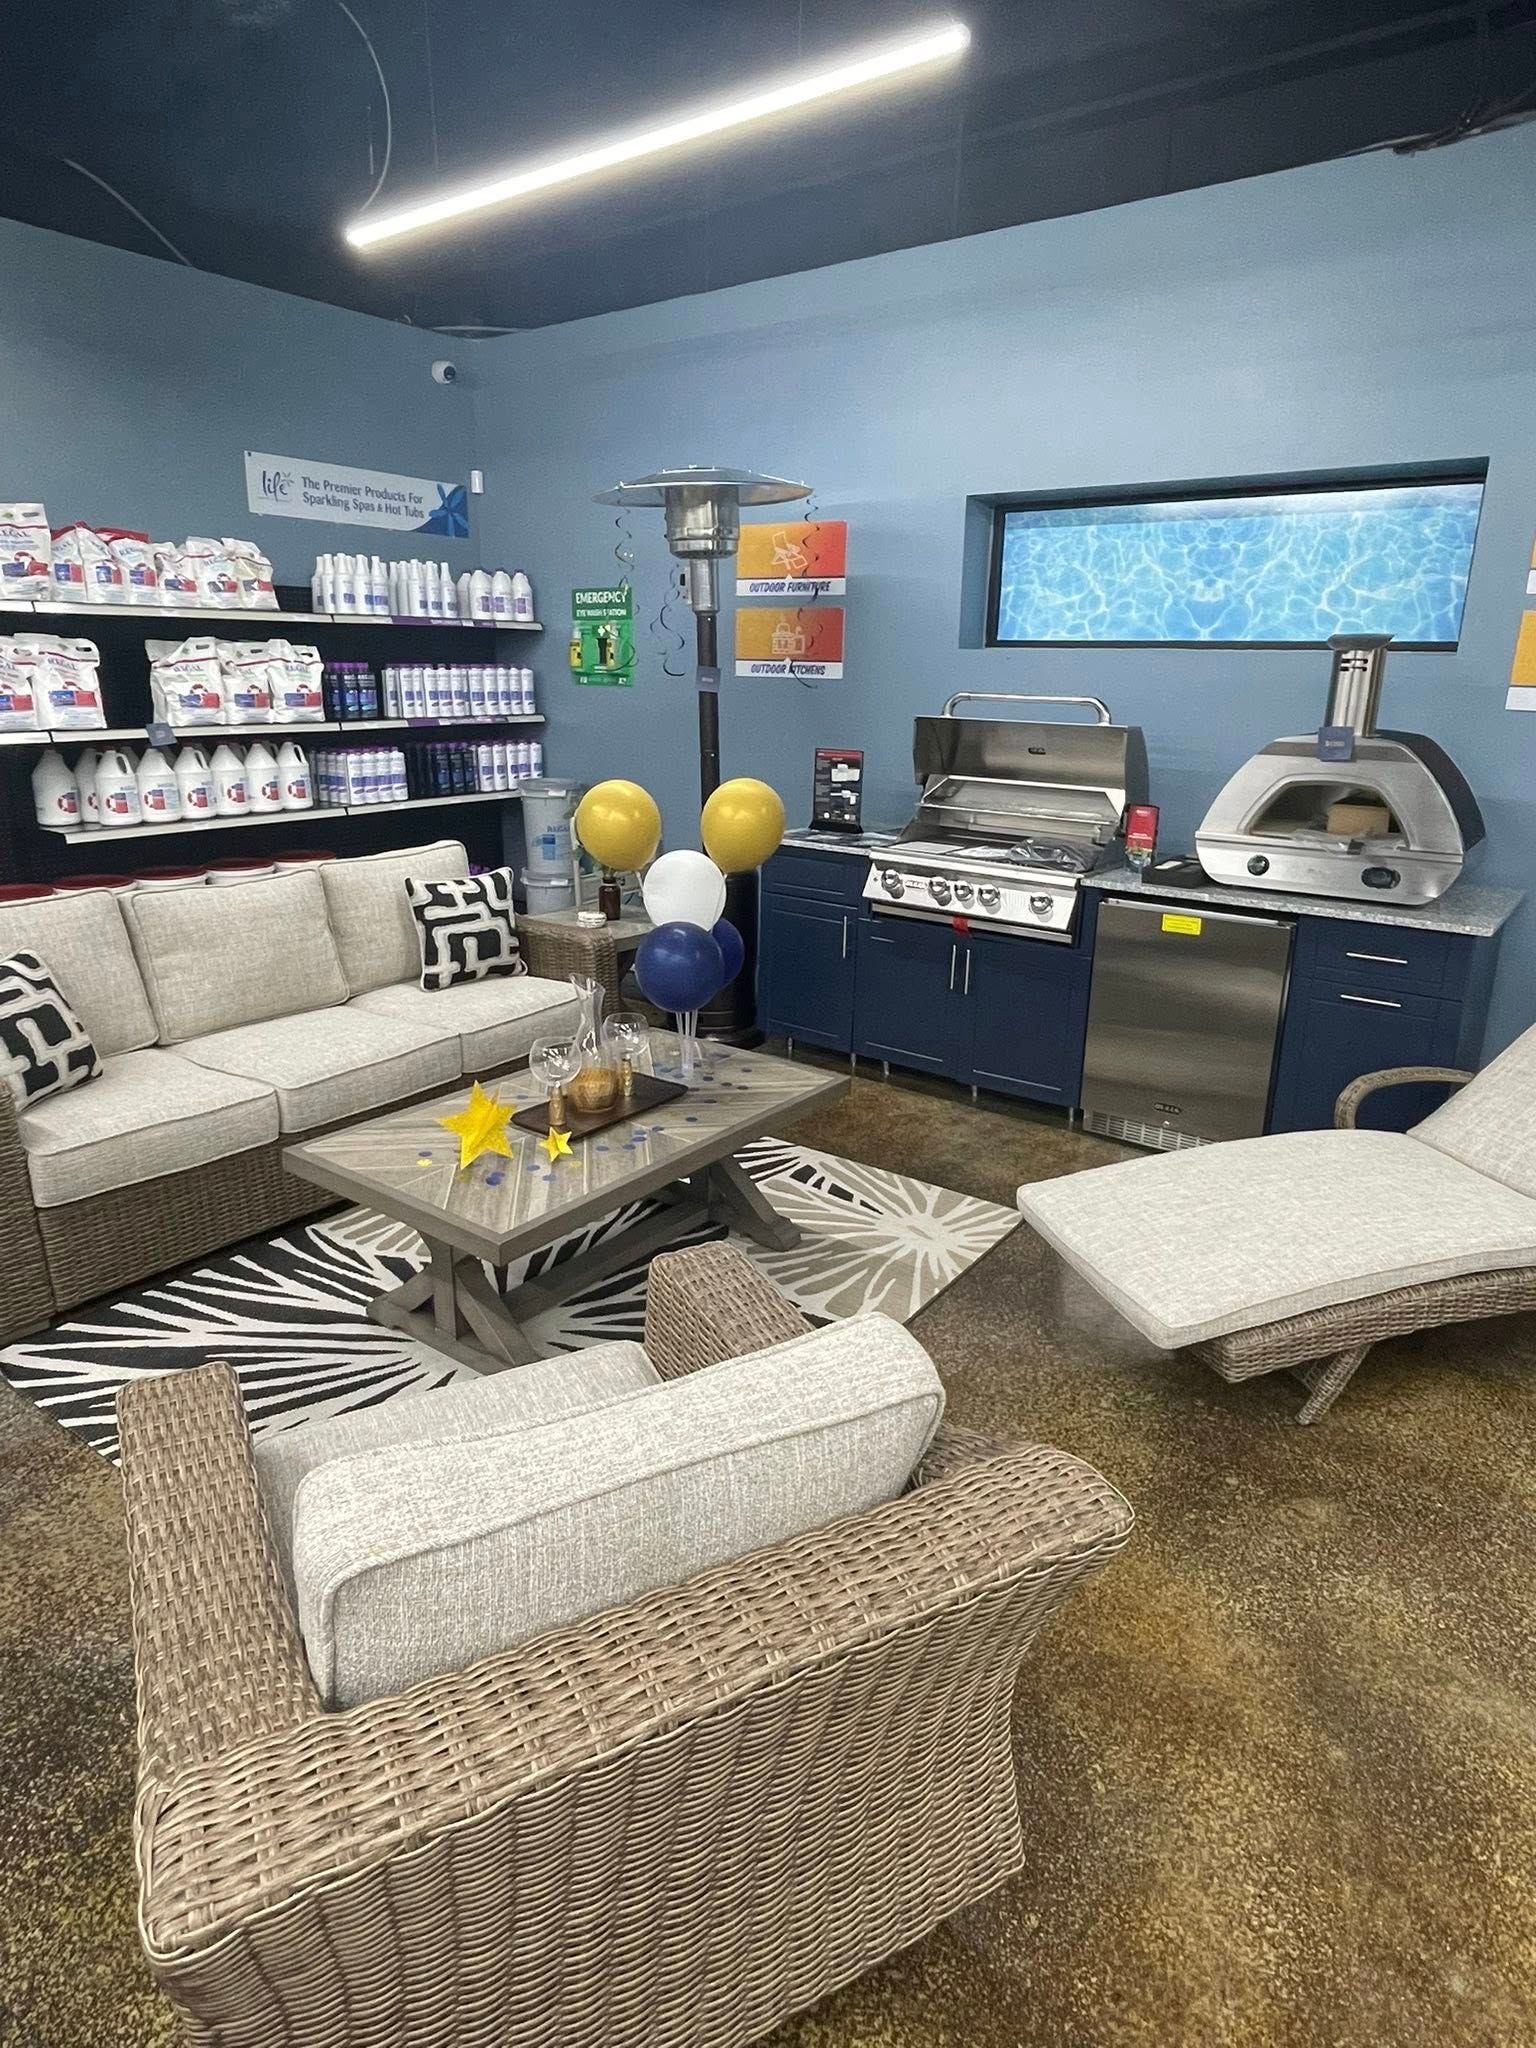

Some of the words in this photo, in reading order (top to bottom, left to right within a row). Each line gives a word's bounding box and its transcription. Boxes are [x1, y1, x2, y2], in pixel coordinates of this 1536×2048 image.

[262, 470, 288, 502] life
[302, 476, 321, 491] The
[323, 480, 363, 497] Premier
[365, 485, 407, 504] Products
[408, 492, 423, 505] For
[303, 492, 350, 512] Sparkling
[352, 499, 375, 514] Spas
[376, 503, 384, 513] &
[385, 502, 402, 516] Hot
[404, 505, 425, 519] Tubs
[749, 582, 785, 593] OUTDOOR
[787, 581, 831, 593] FURNITURE
[575, 591, 627, 604] EMERGENCY
[751, 664, 786, 674] OUTDOOR
[789, 664, 825, 675] KITCHENS
